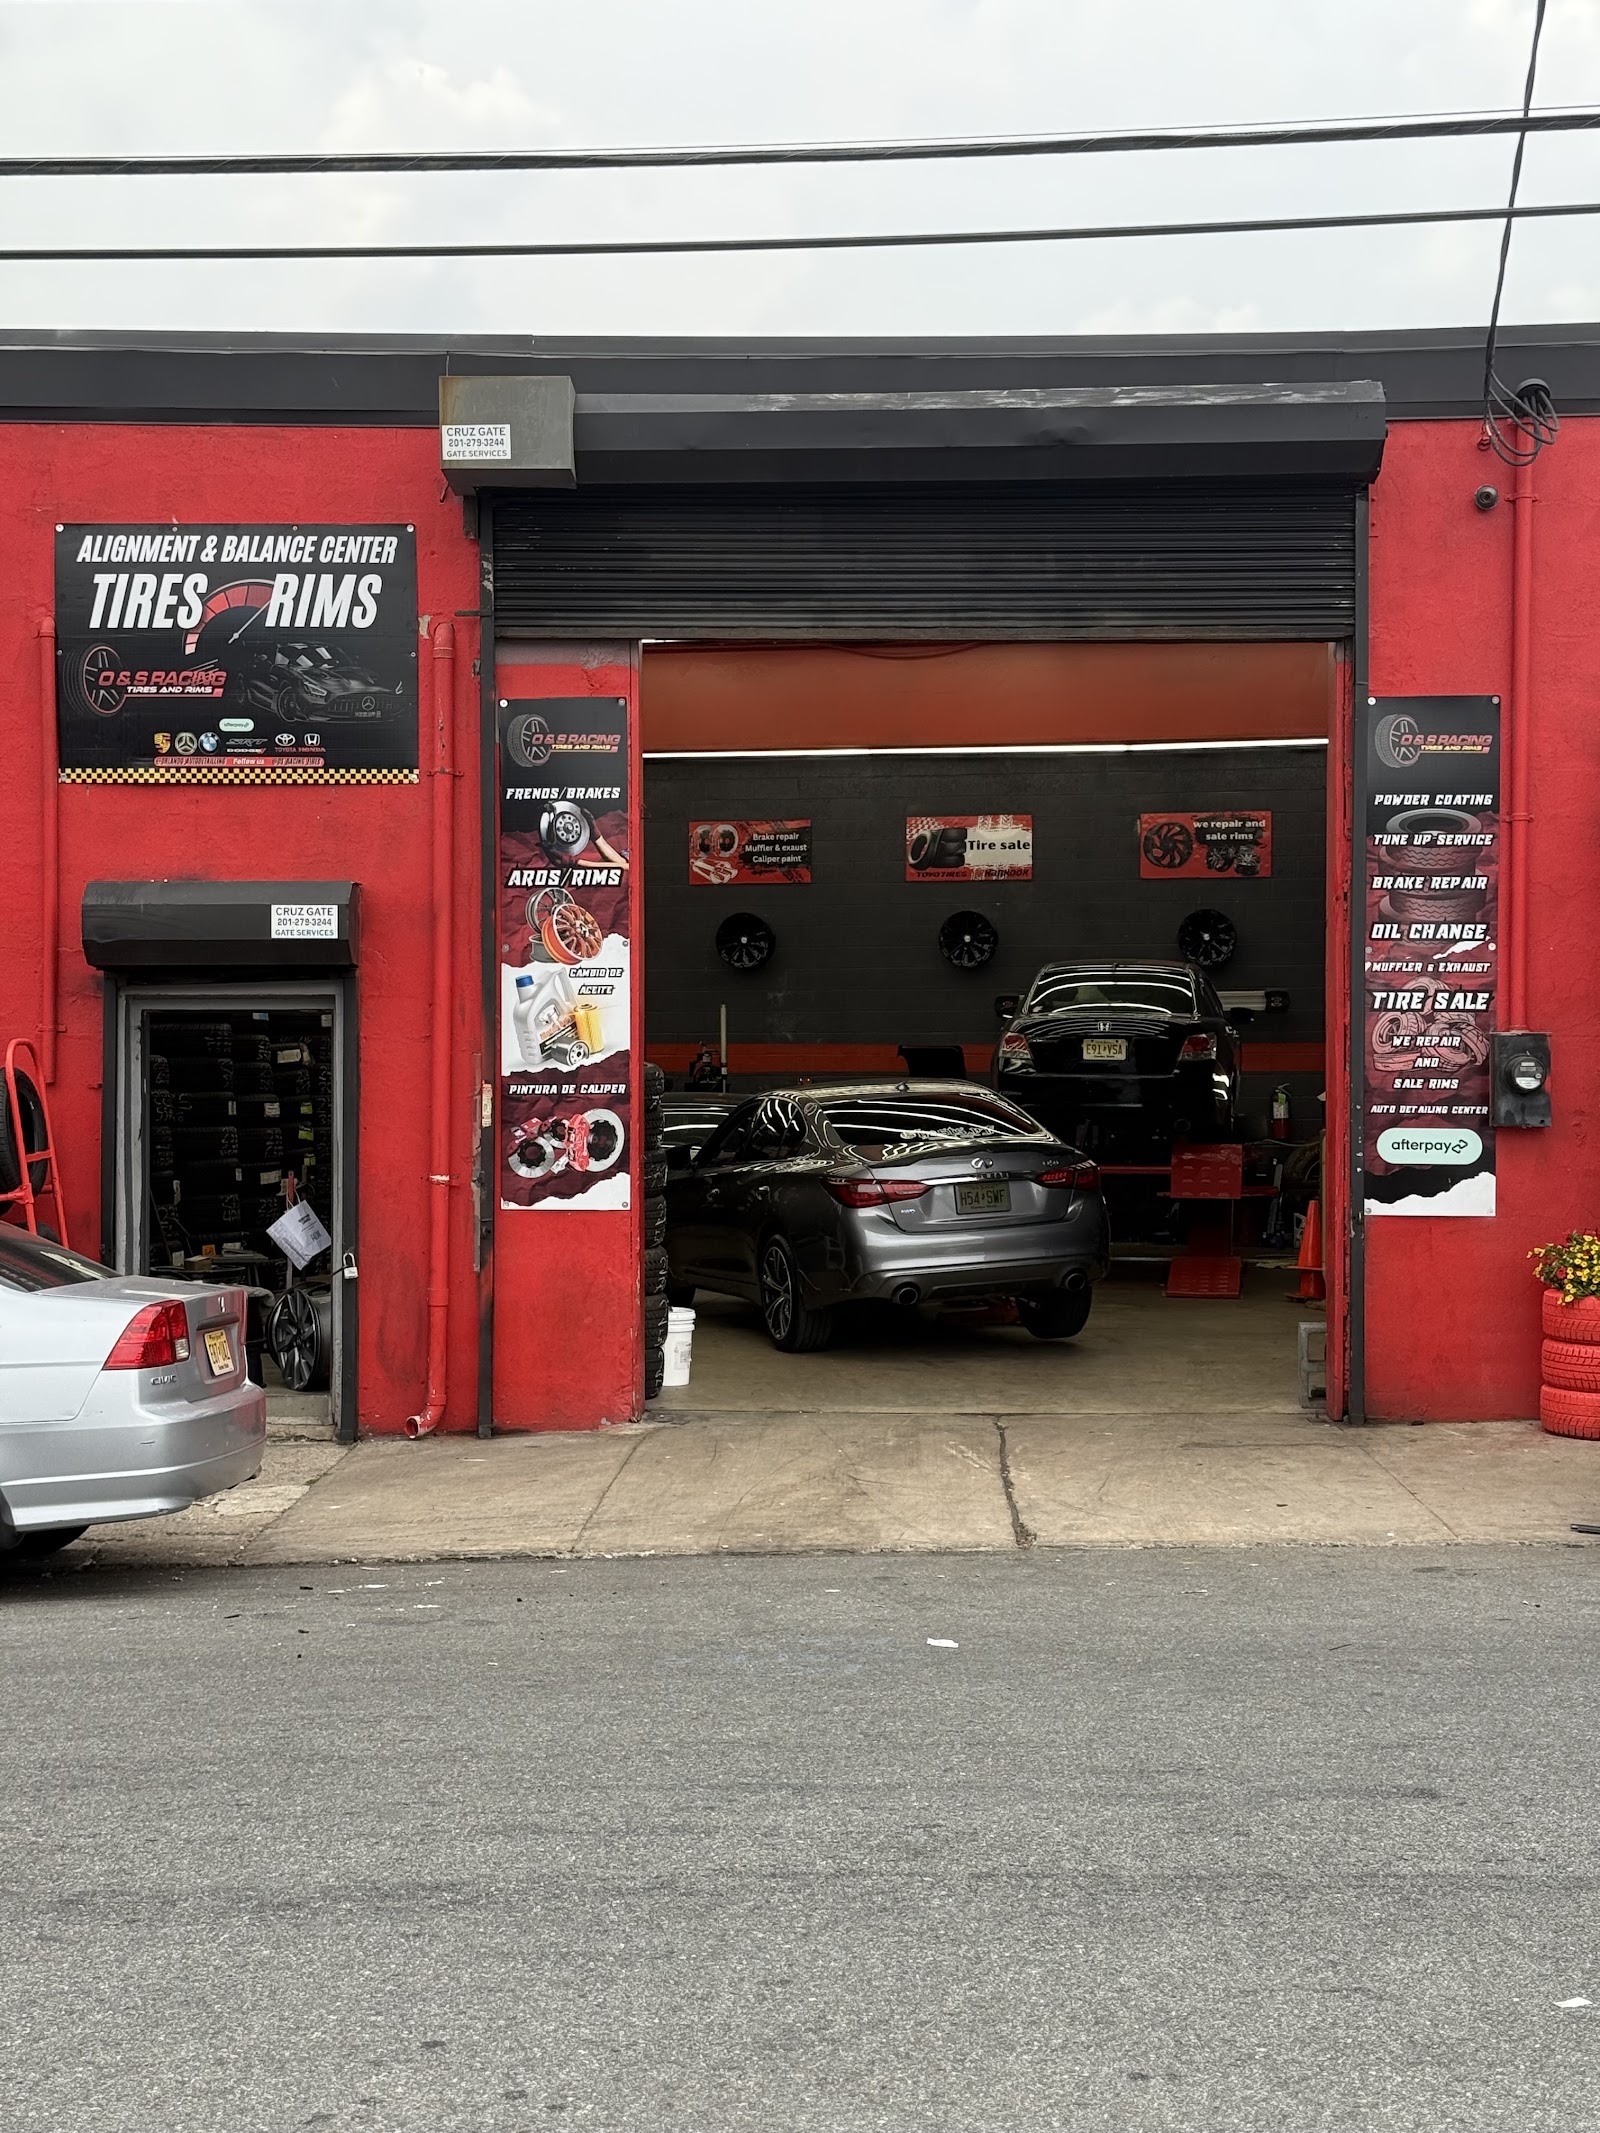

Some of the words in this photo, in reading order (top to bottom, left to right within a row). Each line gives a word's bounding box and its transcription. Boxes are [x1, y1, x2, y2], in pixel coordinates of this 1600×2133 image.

[447, 428, 476, 436] CRUZ
[478, 427, 506, 436] GATE
[449, 439, 504, 447] 201-279-3244
[76, 535, 201, 563] ALIGNMENT
[200, 536, 218, 562] &
[220, 535, 317, 562] BALANCE
[319, 536, 398, 563] CENTER
[88, 573, 209, 628] TIRES
[264, 573, 382, 628] RIMS
[116, 671, 131, 686] &
[133, 671, 149, 686] S
[150, 671, 227, 686] RACING
[544, 734, 555, 745] &
[556, 734, 567, 745] S
[567, 734, 621, 745] RACING
[1413, 735, 1425, 745] &
[1426, 735, 1437, 745] S
[1437, 735, 1492, 745] RACING
[1374, 794, 1430, 806] POWDER
[1435, 794, 1493, 806] COATING
[1210, 820, 1243, 829] repair
[1245, 820, 1266, 828] and
[753, 833, 774, 841] Brake
[776, 833, 799, 842] repair
[1205, 832, 1227, 840] sale
[1230, 832, 1254, 840] rims
[1374, 834, 1408, 846] TUNE
[1437, 834, 1493, 846] SERVICE
[745, 844, 773, 852] Muffler
[967, 840, 996, 850] Tire
[1000, 840, 1030, 850] sale
[752, 856, 780, 864] Caliper
[781, 855, 802, 864] paint
[1372, 876, 1424, 890] BRAKE
[1430, 876, 1488, 890] REPAIR
[276, 907, 304, 916] CRUZ
[306, 907, 334, 916] GATE
[277, 918, 331, 926] 201-279-3244
[1371, 924, 1401, 939] OIL
[1409, 924, 1487, 940] CHANGE
[1372, 962, 1423, 972] MUFFLER
[1438, 963, 1491, 972] EXHAUST
[570, 968, 606, 977] CAMBIO
[609, 968, 623, 977] DE
[579, 985, 613, 995] ACEITE
[1373, 992, 1425, 1010] TIRE
[1434, 992, 1490, 1010] SALE
[1392, 1036, 1412, 1047] WE
[1416, 1036, 1461, 1047] REPAIR
[1415, 1057, 1439, 1068] AND
[509, 1084, 557, 1094] PINTURA
[562, 1084, 576, 1094] DE
[581, 1084, 626, 1094] CALIPER
[1393, 1079, 1423, 1089] SALE
[1428, 1079, 1459, 1089] RIMS
[1370, 1105, 1396, 1114] AUTO
[1399, 1105, 1448, 1114] DETAILING
[1451, 1105, 1489, 1115] CENTER
[1391, 1139, 1452, 1154] afterpay
[150, 1374, 177, 1385] CIVIC
